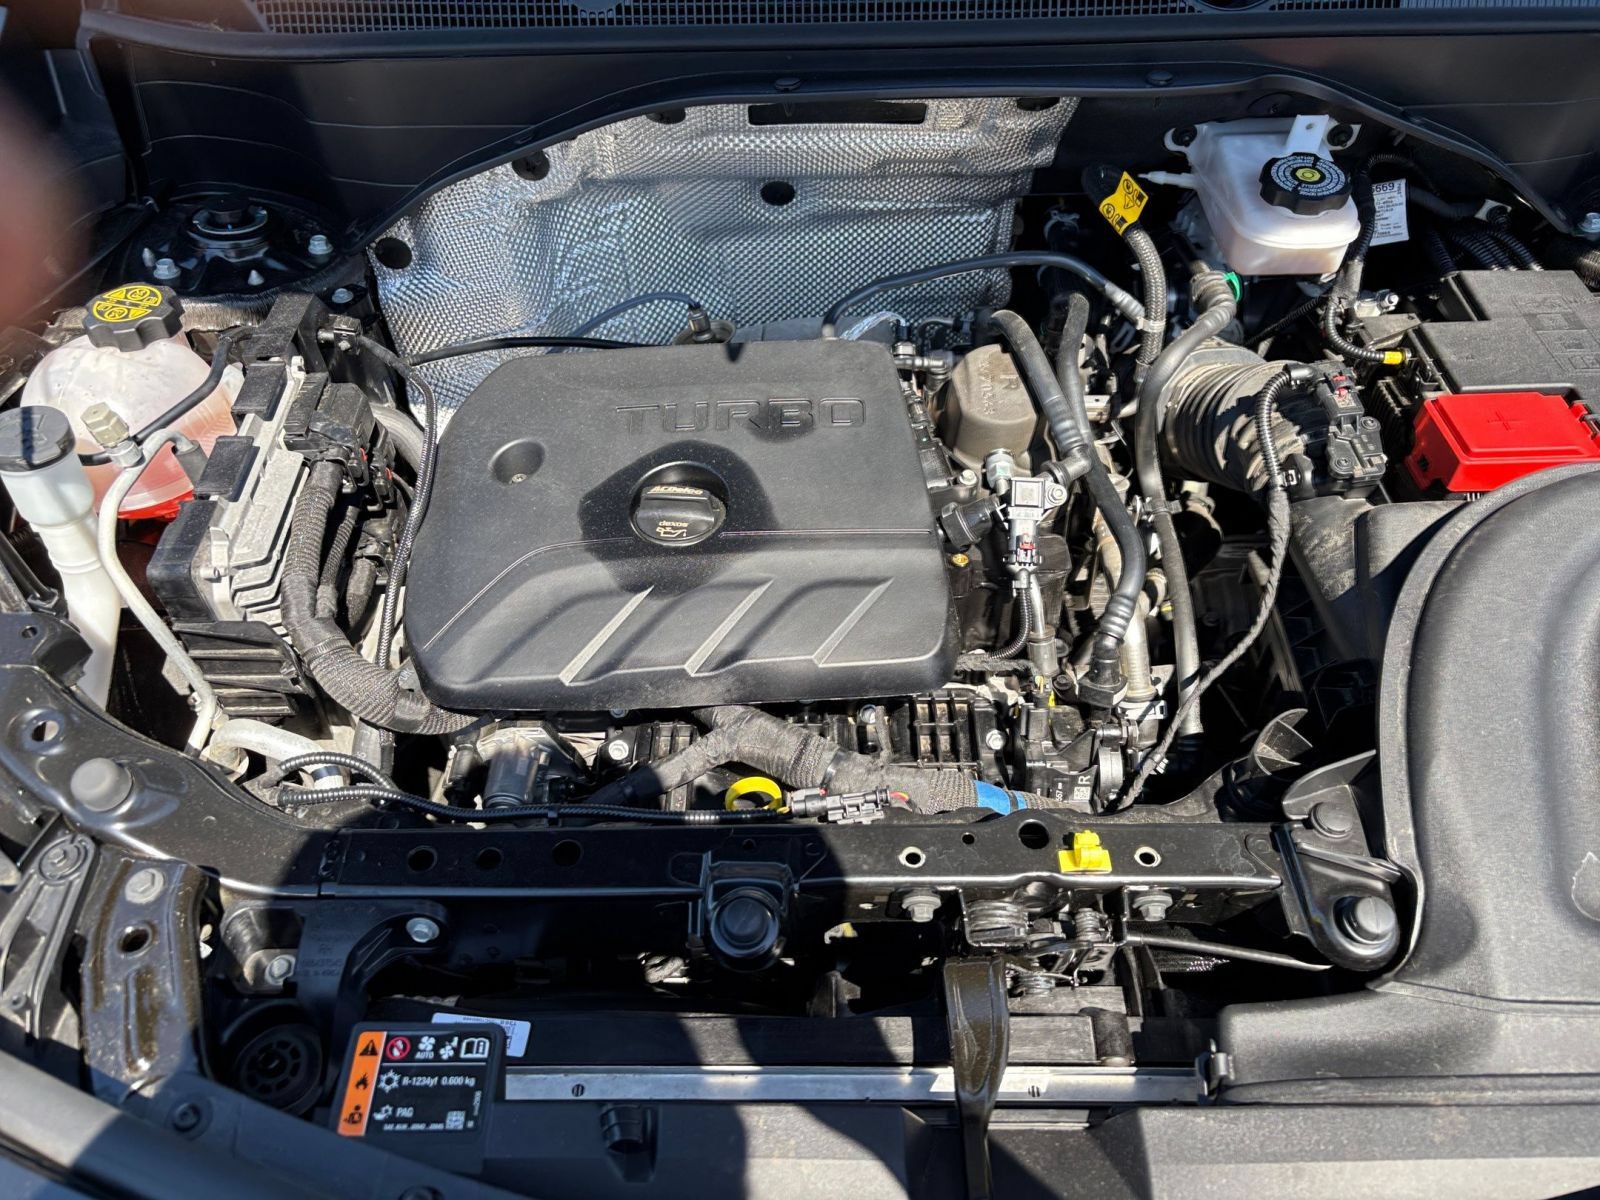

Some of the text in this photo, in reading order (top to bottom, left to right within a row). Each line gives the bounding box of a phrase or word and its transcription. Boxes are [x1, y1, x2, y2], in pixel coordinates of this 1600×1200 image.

[616, 397, 866, 434] TURBO
[647, 486, 703, 495] ACDelco
[659, 520, 689, 528] dexos
[1078, 775, 1090, 784] R
[415, 1051, 435, 1060] AUTO
[402, 1076, 476, 1087] R-1234yf 0.600 kg
[395, 1107, 414, 1118] PAG
